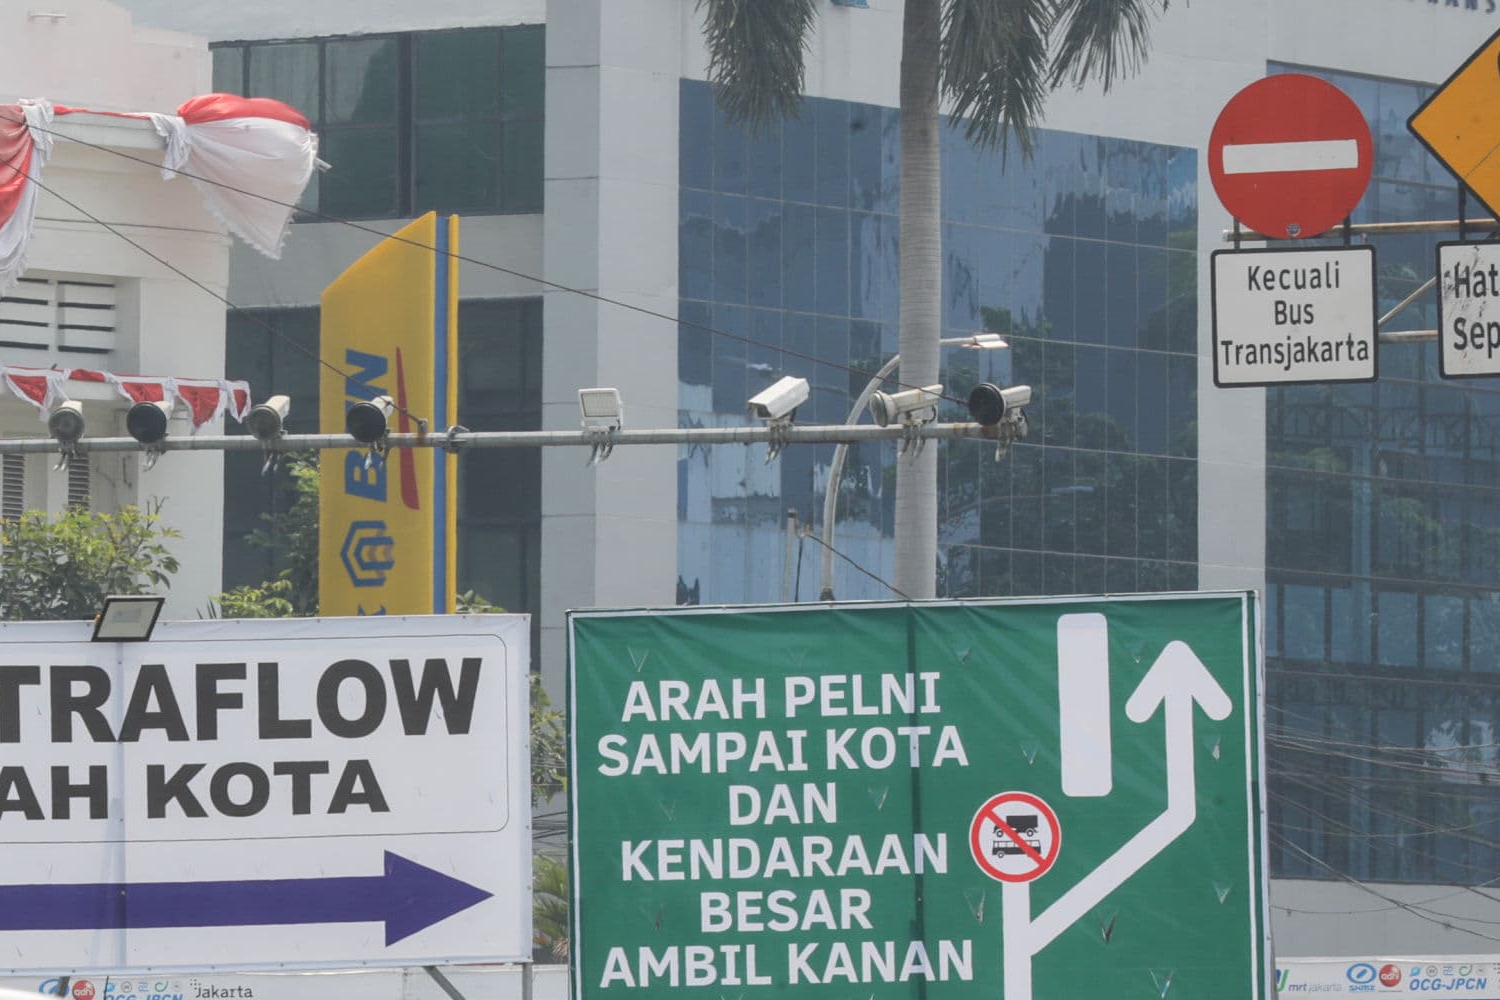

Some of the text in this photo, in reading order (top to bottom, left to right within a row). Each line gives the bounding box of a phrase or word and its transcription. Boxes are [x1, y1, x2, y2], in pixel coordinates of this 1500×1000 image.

[1247, 261, 1340, 291] Kecuali
[1453, 262, 1499, 298] Hat
[1274, 300, 1315, 325] Bus
[1221, 333, 1370, 372] Transjakarta
[1453, 317, 1500, 359] Sep
[344, 348, 388, 503] BN
[621, 671, 941, 722] ARAH PELNI
[598, 725, 969, 776] SAMPAI KOTA
[146, 760, 390, 819] KOTA
[729, 782, 837, 825] DAN
[622, 833, 948, 880] KENDARAAN
[700, 888, 872, 932] BESAR
[600, 939, 974, 988] AMBIL KANAN
[1409, 978, 1487, 991] OCG-JPCN
